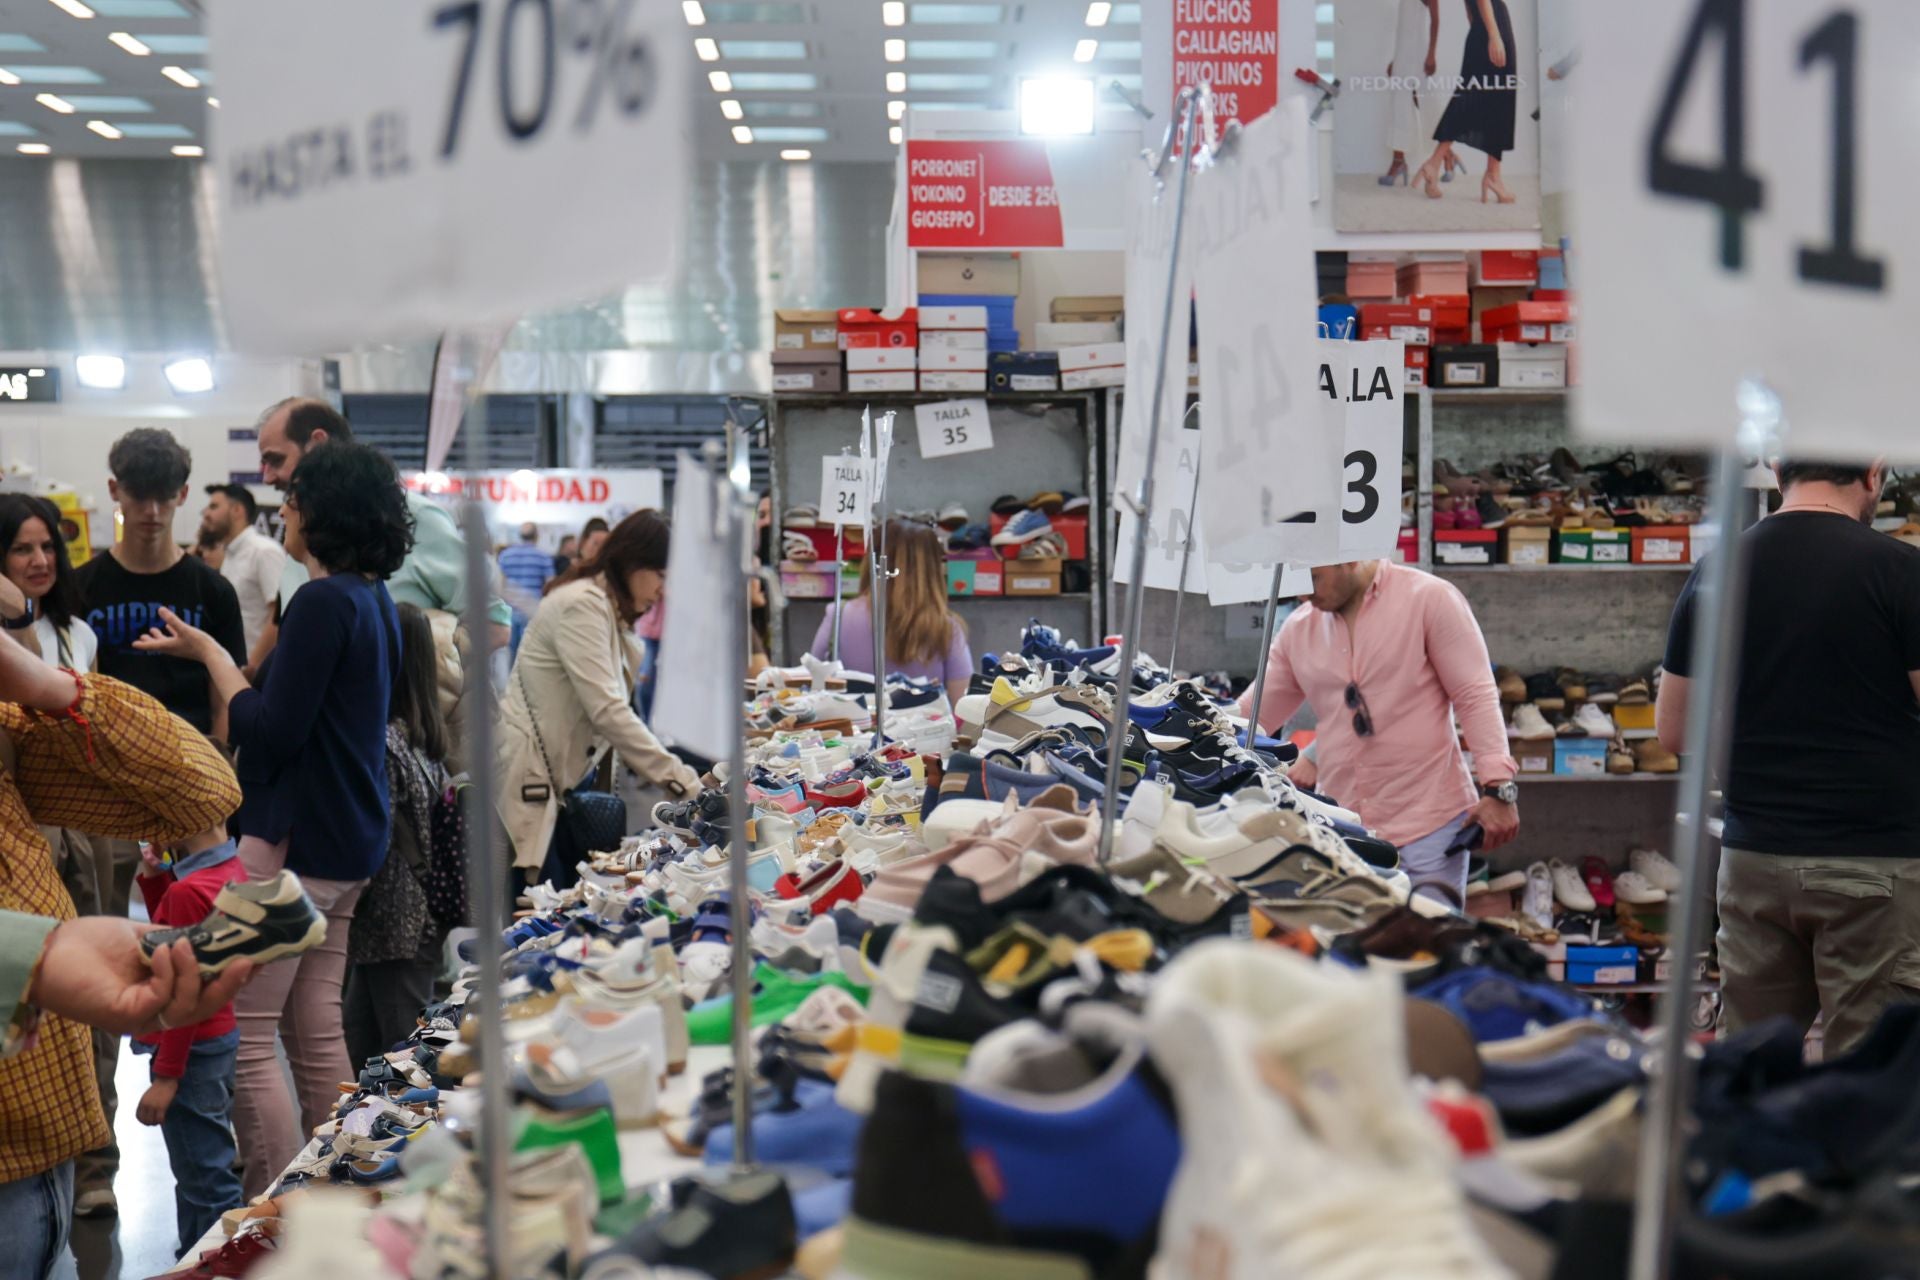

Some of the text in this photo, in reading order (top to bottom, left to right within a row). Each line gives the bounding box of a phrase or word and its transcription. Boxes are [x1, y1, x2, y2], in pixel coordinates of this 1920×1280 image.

[1175, 0, 1252, 24] FLUCHOS
[1175, 29, 1277, 55] CALLAGHAN
[1175, 61, 1263, 86] PIKOLINOS
[1350, 75, 1527, 91] PEDRO MIRALLES
[229, 0, 659, 206] HASTA EL 70%
[1647, 0, 1885, 292] 41
[911, 159, 977, 177] PORRONET
[911, 185, 967, 203] YOKONO
[988, 186, 1033, 207] DESDE
[911, 210, 976, 229] GIOSEPPO
[934, 407, 971, 421] TALLA
[942, 426, 968, 446] 35
[835, 467, 862, 482] TALLA
[837, 491, 856, 514] 34
